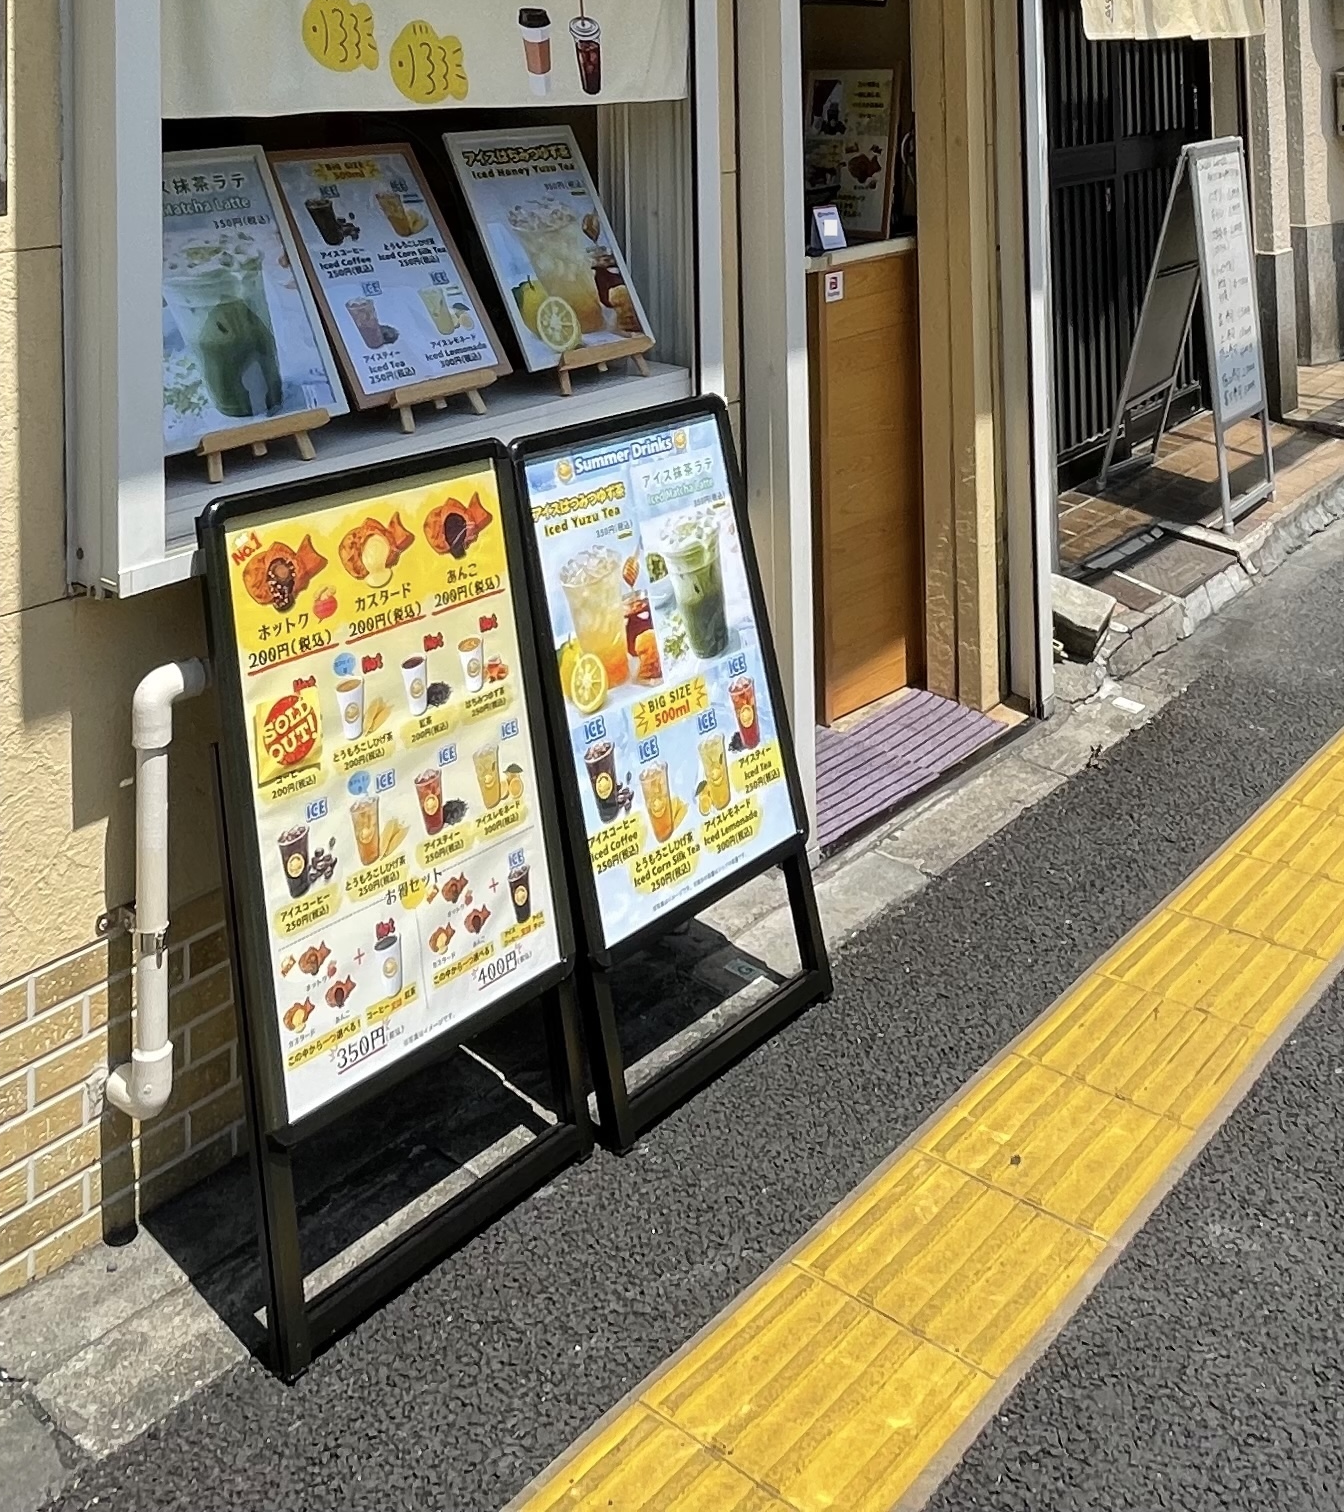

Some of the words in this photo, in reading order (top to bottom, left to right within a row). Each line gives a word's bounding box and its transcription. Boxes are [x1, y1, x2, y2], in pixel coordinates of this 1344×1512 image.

[471, 169, 495, 180] Iced
[497, 167, 530, 176] Honey
[213, 195, 251, 211] Latte
[319, 260, 340, 270] Iced
[341, 256, 371, 266] Coffee
[369, 364, 389, 374] Iced
[390, 360, 405, 369] Tea
[425, 351, 444, 361] Iced
[575, 447, 629, 475] Summer
[630, 435, 672, 460] Drinks
[544, 519, 569, 537] Iced
[571, 512, 600, 528] Yuzu
[601, 506, 621, 519] Tea
[447, 563, 478, 584] あんこ
[355, 582, 411, 612] カスタード
[434, 574, 501, 608] 200円(税込)
[258, 613, 309, 641] ホットク
[349, 601, 422, 638] 200円(税込)
[248, 629, 332, 669] 200円(税込)
[728, 655, 745, 675] ICE
[648, 695, 666, 713] BIG
[669, 684, 692, 703] SIZE
[264, 700, 312, 744] SOLD
[655, 699, 691, 727] 500ml
[698, 710, 715, 731] ICE
[269, 713, 317, 763] OUT!
[501, 720, 517, 738] ICE
[584, 718, 605, 740] ICE
[439, 746, 456, 764] ICE
[639, 738, 657, 760] ICE
[376, 771, 394, 790] ICE
[744, 768, 759, 780] Iced
[760, 760, 772, 771] Tea
[306, 799, 326, 819] ICE
[703, 831, 720, 846] Iced
[721, 809, 758, 837] Lemonade
[590, 843, 609, 862] Iced
[610, 831, 638, 851] Coffee
[508, 849, 524, 867] ICE
[634, 873, 651, 888] Iced
[652, 861, 671, 877] Corn
[687, 843, 700, 856] Tea
[281, 893, 330, 923] アイスコーヒー
